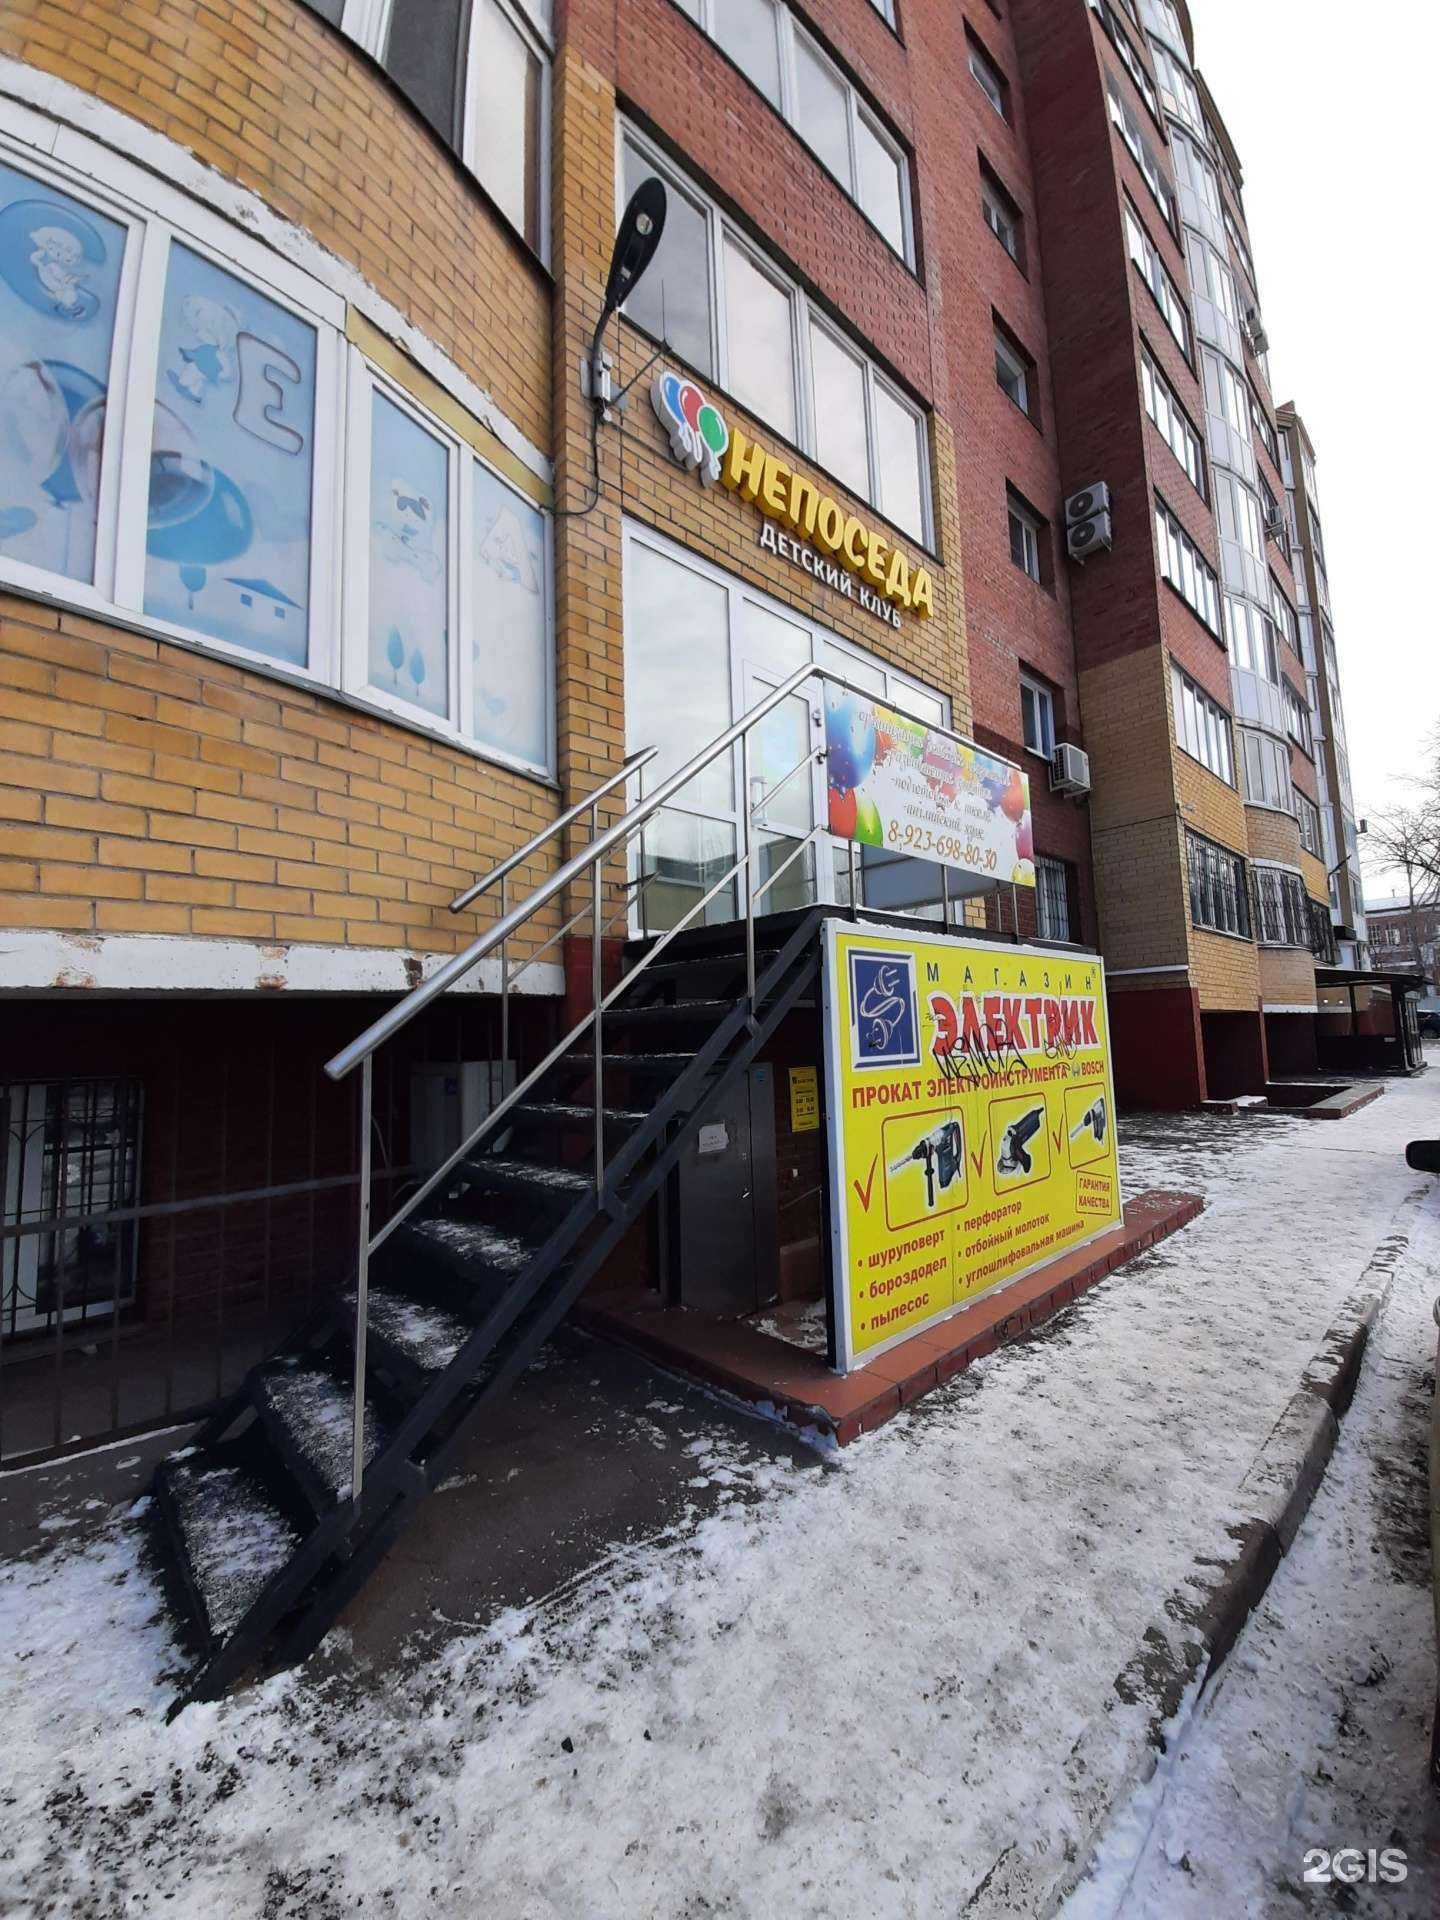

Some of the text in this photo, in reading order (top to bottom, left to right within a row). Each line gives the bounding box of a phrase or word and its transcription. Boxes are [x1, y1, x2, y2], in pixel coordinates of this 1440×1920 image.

[721, 427, 933, 621] НЕПОСЕДА
[759, 523, 902, 630] ДЕТСКИЙ КЛУБ
[888, 820, 998, 871] 8-923-698-80-30
[930, 995, 1099, 1058] ЭЛЕКТРИК
[851, 1080, 921, 1108] ПРОКАТ
[926, 1065, 1068, 1098] ЭЛЕКТРОИНСТРУМЕНТА
[1081, 1060, 1104, 1076] BOSCH
[963, 1200, 1022, 1233] перфоратор
[964, 1213, 1051, 1258] отбойный молоток
[867, 1229, 946, 1269] шуруповерт
[965, 1234, 1055, 1287] углошлифовальная
[869, 1256, 948, 1299] бороздодел
[870, 1292, 930, 1331] пылесос
